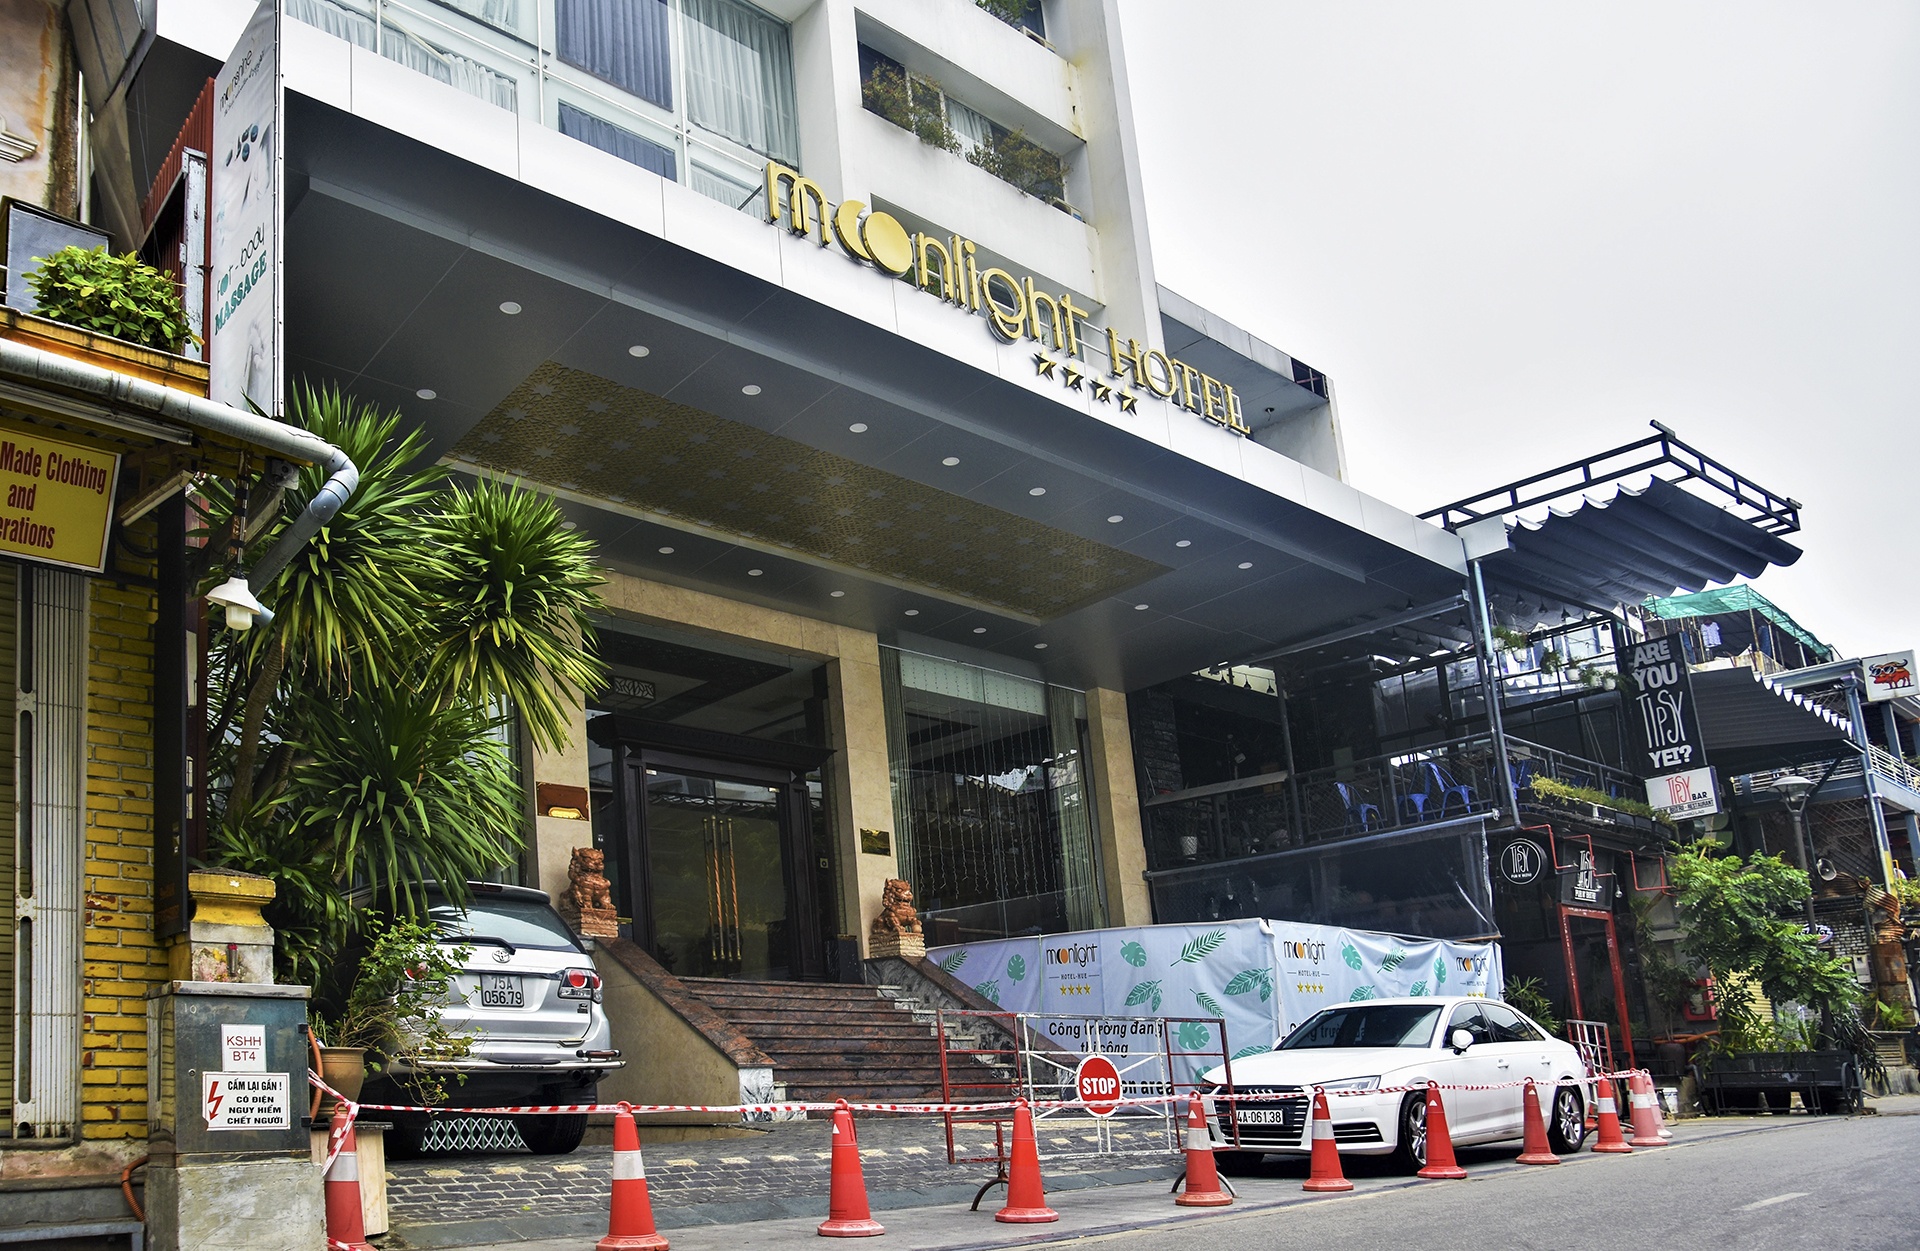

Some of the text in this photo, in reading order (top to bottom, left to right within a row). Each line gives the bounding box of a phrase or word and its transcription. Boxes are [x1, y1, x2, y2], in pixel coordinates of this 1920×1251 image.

[215, 250, 267, 336] MASSAGE
[764, 160, 1250, 436] moonlight HOTEL
[1, 440, 107, 495] Made Clothing
[7, 483, 37, 511] and
[1633, 640, 1671, 668] ARE
[1632, 662, 1678, 691] YOU
[1636, 689, 1686, 749] TIPSY
[1648, 744, 1692, 769] YET?
[1666, 776, 1707, 805] TIPSY BAR
[1510, 845, 1530, 874] TIPSY
[1046, 943, 1098, 968] moonlight
[1283, 938, 1325, 965] moonlight
[492, 977, 514, 990] 75A
[484, 990, 522, 1005] 056.79
[226, 1036, 262, 1046] KSHH
[1049, 1022, 1081, 1039] Công
[1130, 1019, 1163, 1039] đang
[232, 1051, 256, 1061] BT4
[227, 1078, 246, 1091] CẤM
[247, 1081, 260, 1092] LẠI
[1082, 1077, 1117, 1095] STOP
[1140, 1080, 1172, 1096] area
[236, 1095, 274, 1105] CÓ ĐIỆN
[227, 1115, 251, 1125] CHẾT
[1236, 1111, 1282, 1123] 4A-061.38
